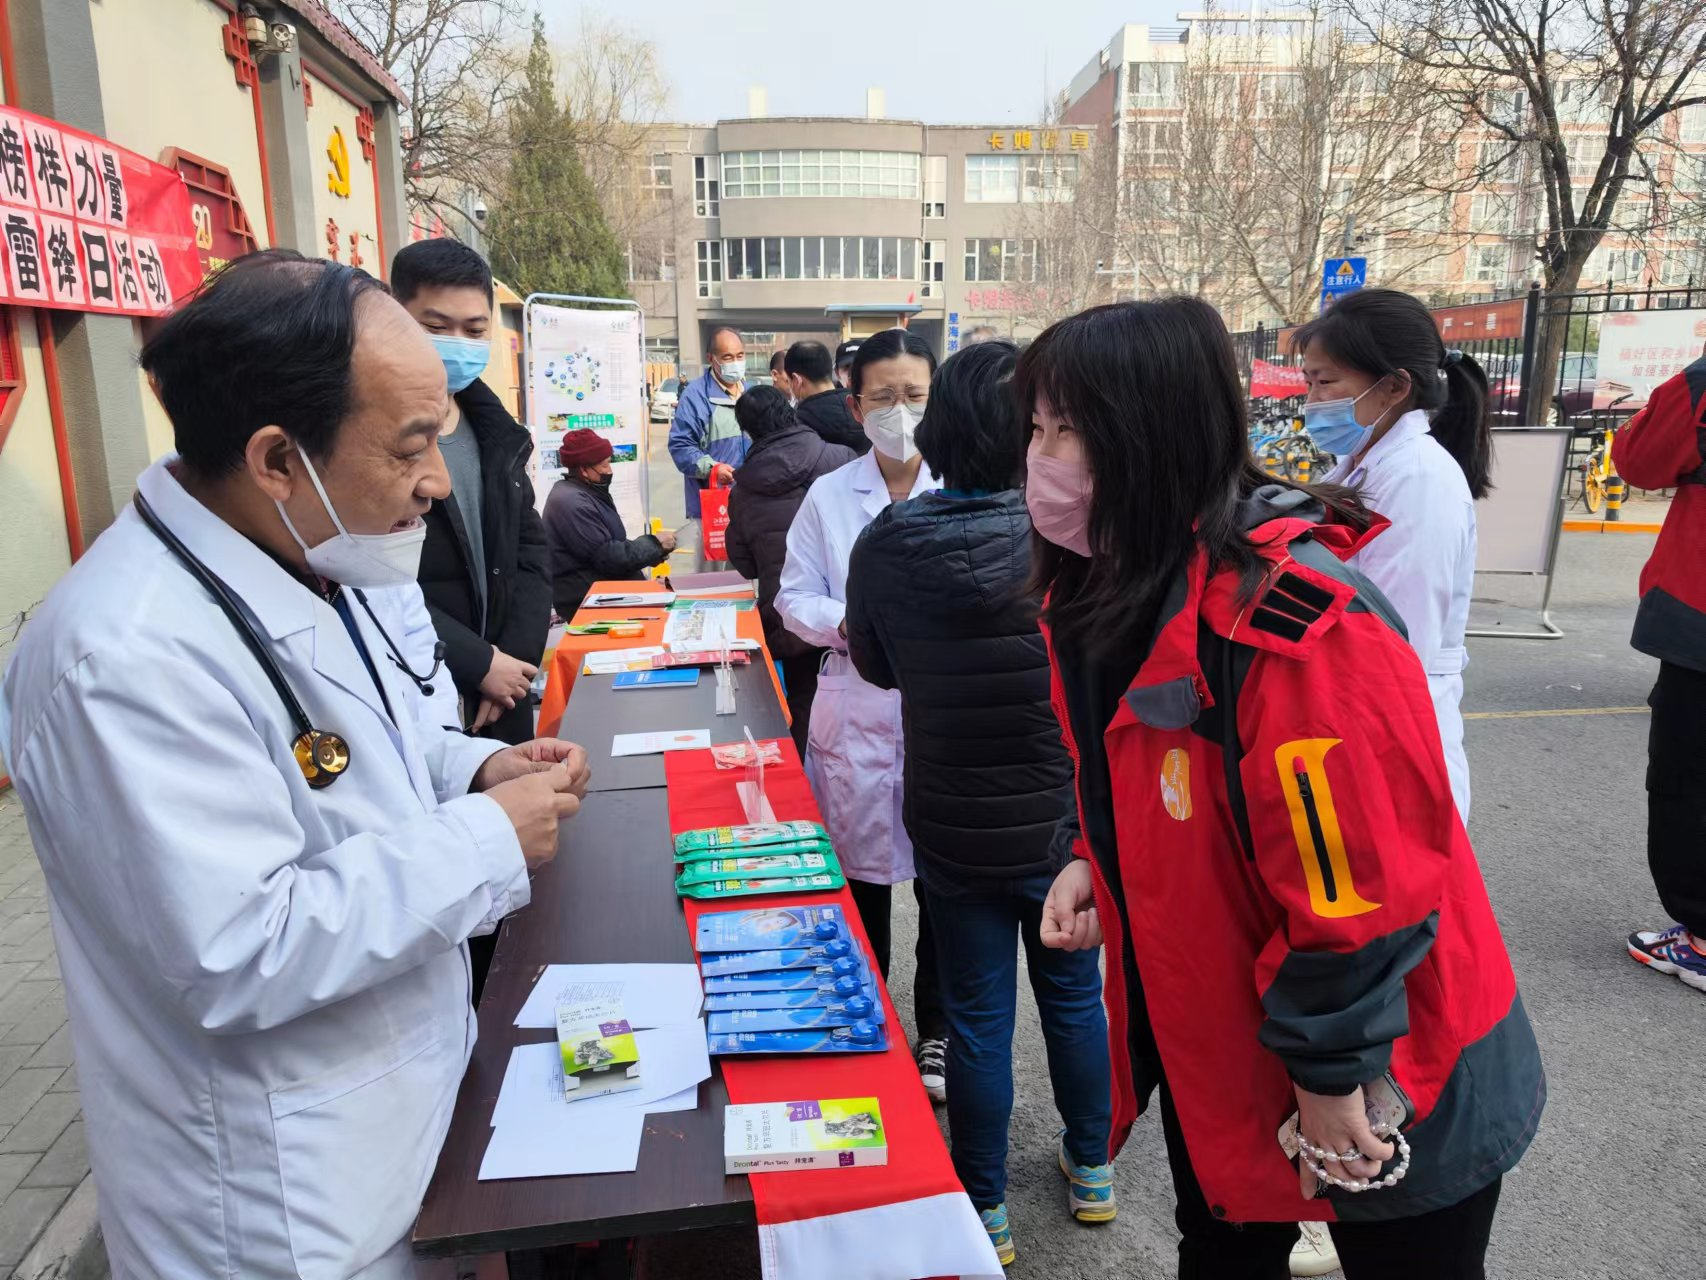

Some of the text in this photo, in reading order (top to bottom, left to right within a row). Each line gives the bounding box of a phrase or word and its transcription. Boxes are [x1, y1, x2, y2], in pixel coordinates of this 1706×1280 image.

[0, 119, 124, 223] 榜样力量
[5, 213, 168, 305] 雷锋日活动
[1326, 275, 1362, 286] 注意行人
[733, 1160, 760, 1168] Drontal
